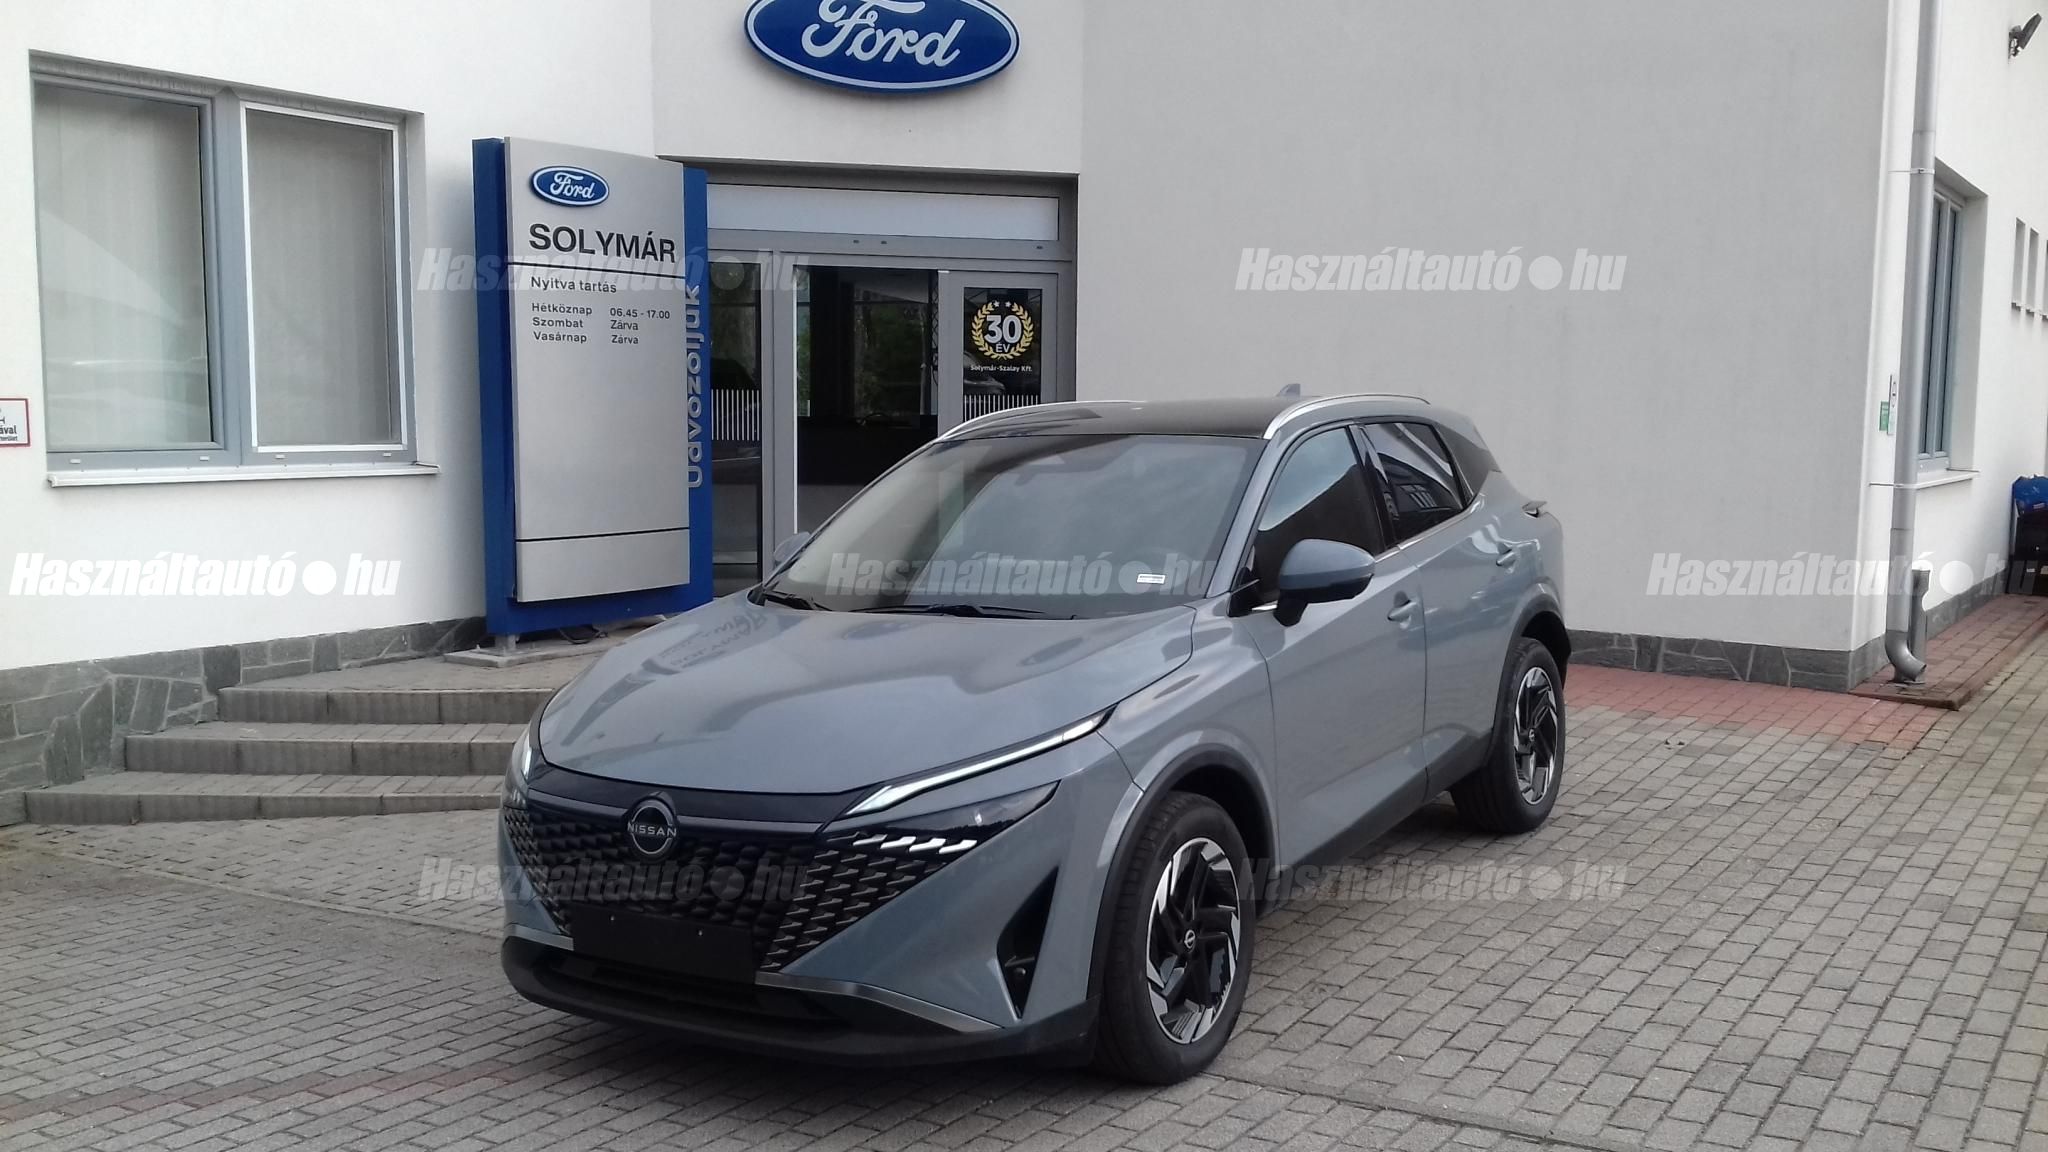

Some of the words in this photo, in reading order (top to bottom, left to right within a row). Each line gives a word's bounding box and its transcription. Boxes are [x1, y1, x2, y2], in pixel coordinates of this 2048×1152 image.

[801, 0, 966, 67] Ford
[549, 172, 596, 199] Ford
[529, 223, 676, 263] SOLYMÁR
[531, 276, 576, 290] Nyitva
[579, 279, 617, 293] tartás
[532, 302, 593, 316] Hétköznap
[610, 307, 638, 318] 06.45
[647, 309, 671, 319] 17.00
[532, 316, 584, 328] Szombat
[610, 319, 639, 331] Zárva
[984, 315, 1022, 344] 30
[533, 331, 587, 343] Vasárnap
[611, 334, 639, 344] Zárva
[627, 821, 677, 837] NISSAN
